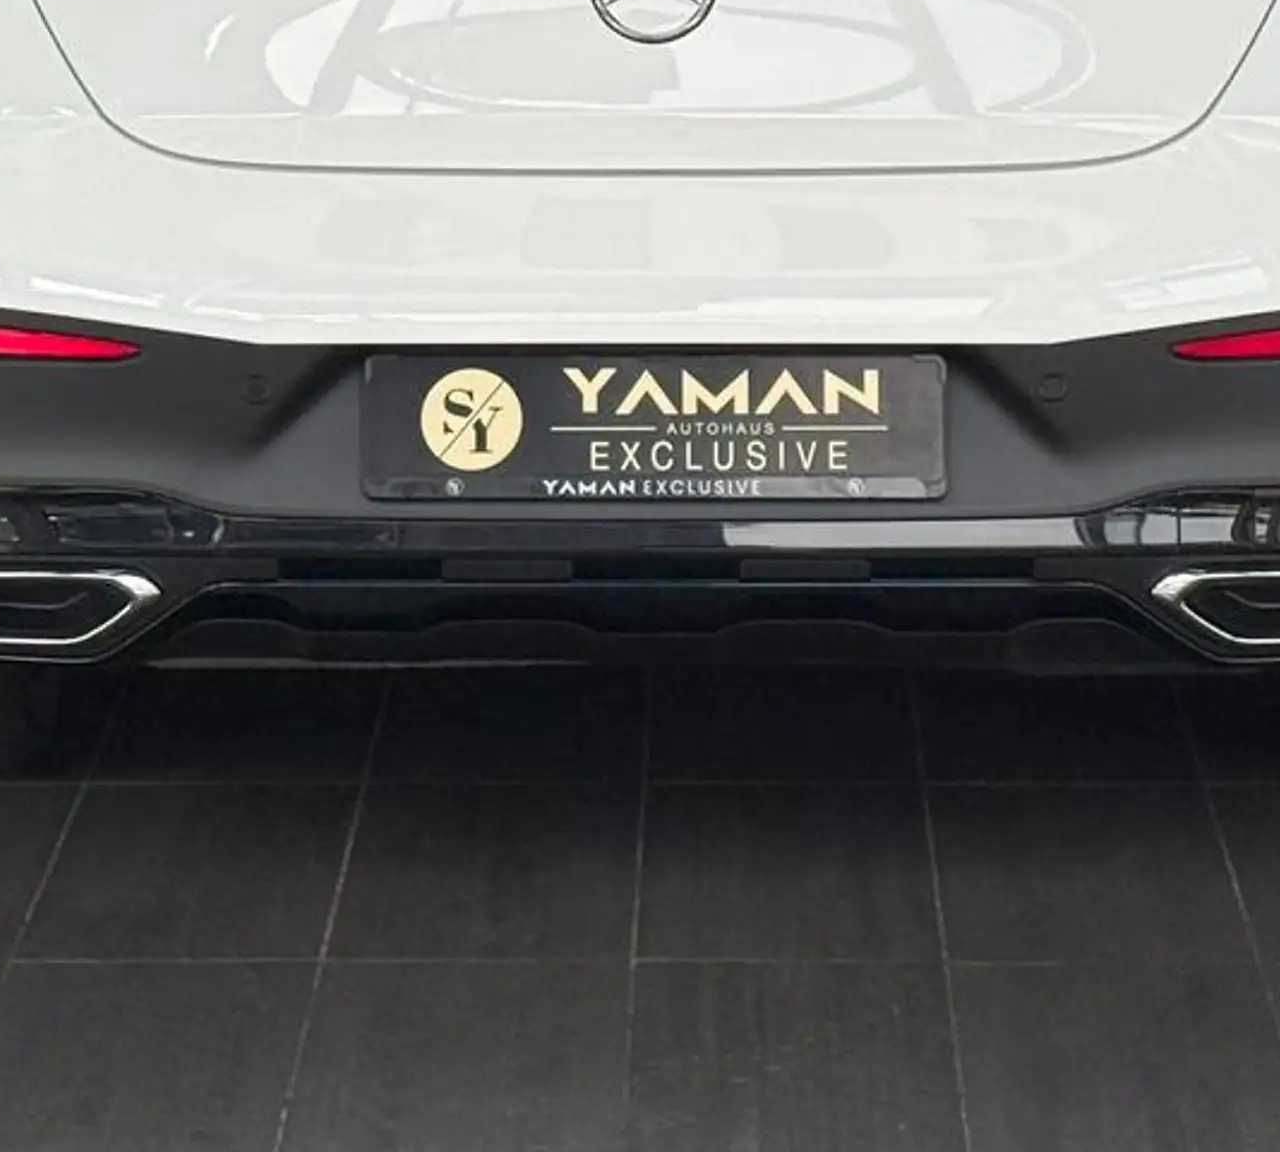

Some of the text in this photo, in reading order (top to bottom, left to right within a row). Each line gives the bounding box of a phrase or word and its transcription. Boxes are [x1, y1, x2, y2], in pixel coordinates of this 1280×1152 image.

[563, 367, 884, 416] YAMAN
[666, 422, 776, 435] AUTOHAUS
[589, 441, 849, 471] EXCLUSIVE
[542, 479, 762, 496] YAMAN EXCLUSIVE
